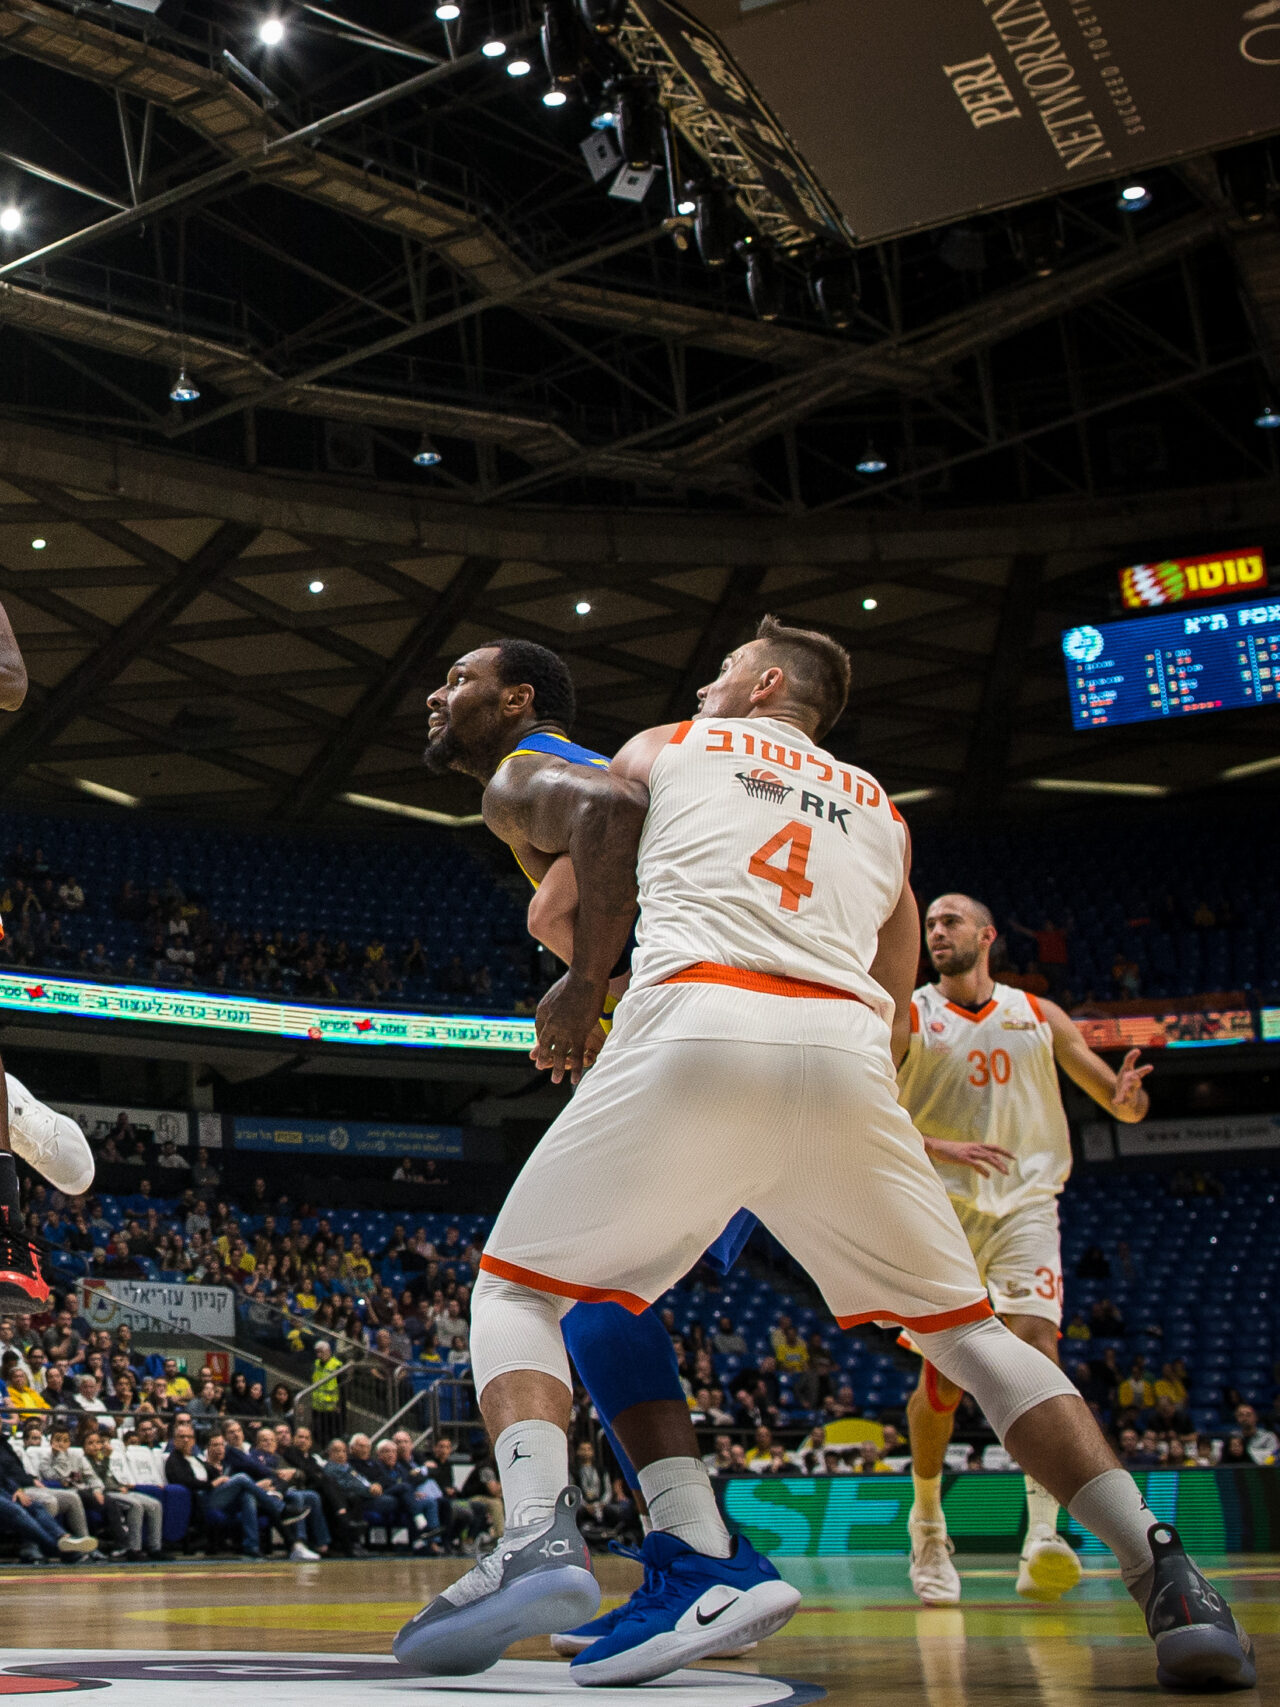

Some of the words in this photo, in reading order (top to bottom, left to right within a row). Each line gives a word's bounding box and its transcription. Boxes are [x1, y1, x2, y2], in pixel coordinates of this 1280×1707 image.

[1072, 2, 1111, 61] TOGET
[942, 53, 1021, 129] PERI
[981, 0, 1112, 170] NETWORKIN
[1099, 65, 1145, 136] SUCCEED
[1185, 556, 1263, 591] טוטו
[705, 729, 881, 808] קולשוב
[800, 790, 852, 836] RK
[747, 820, 814, 913] 4
[967, 1048, 1012, 1088] 30
[123, 1281, 184, 1306] עזריאלי
[191, 1288, 227, 1313] קניון
[123, 1313, 162, 1332] אביב
[168, 1310, 191, 1334] תל
